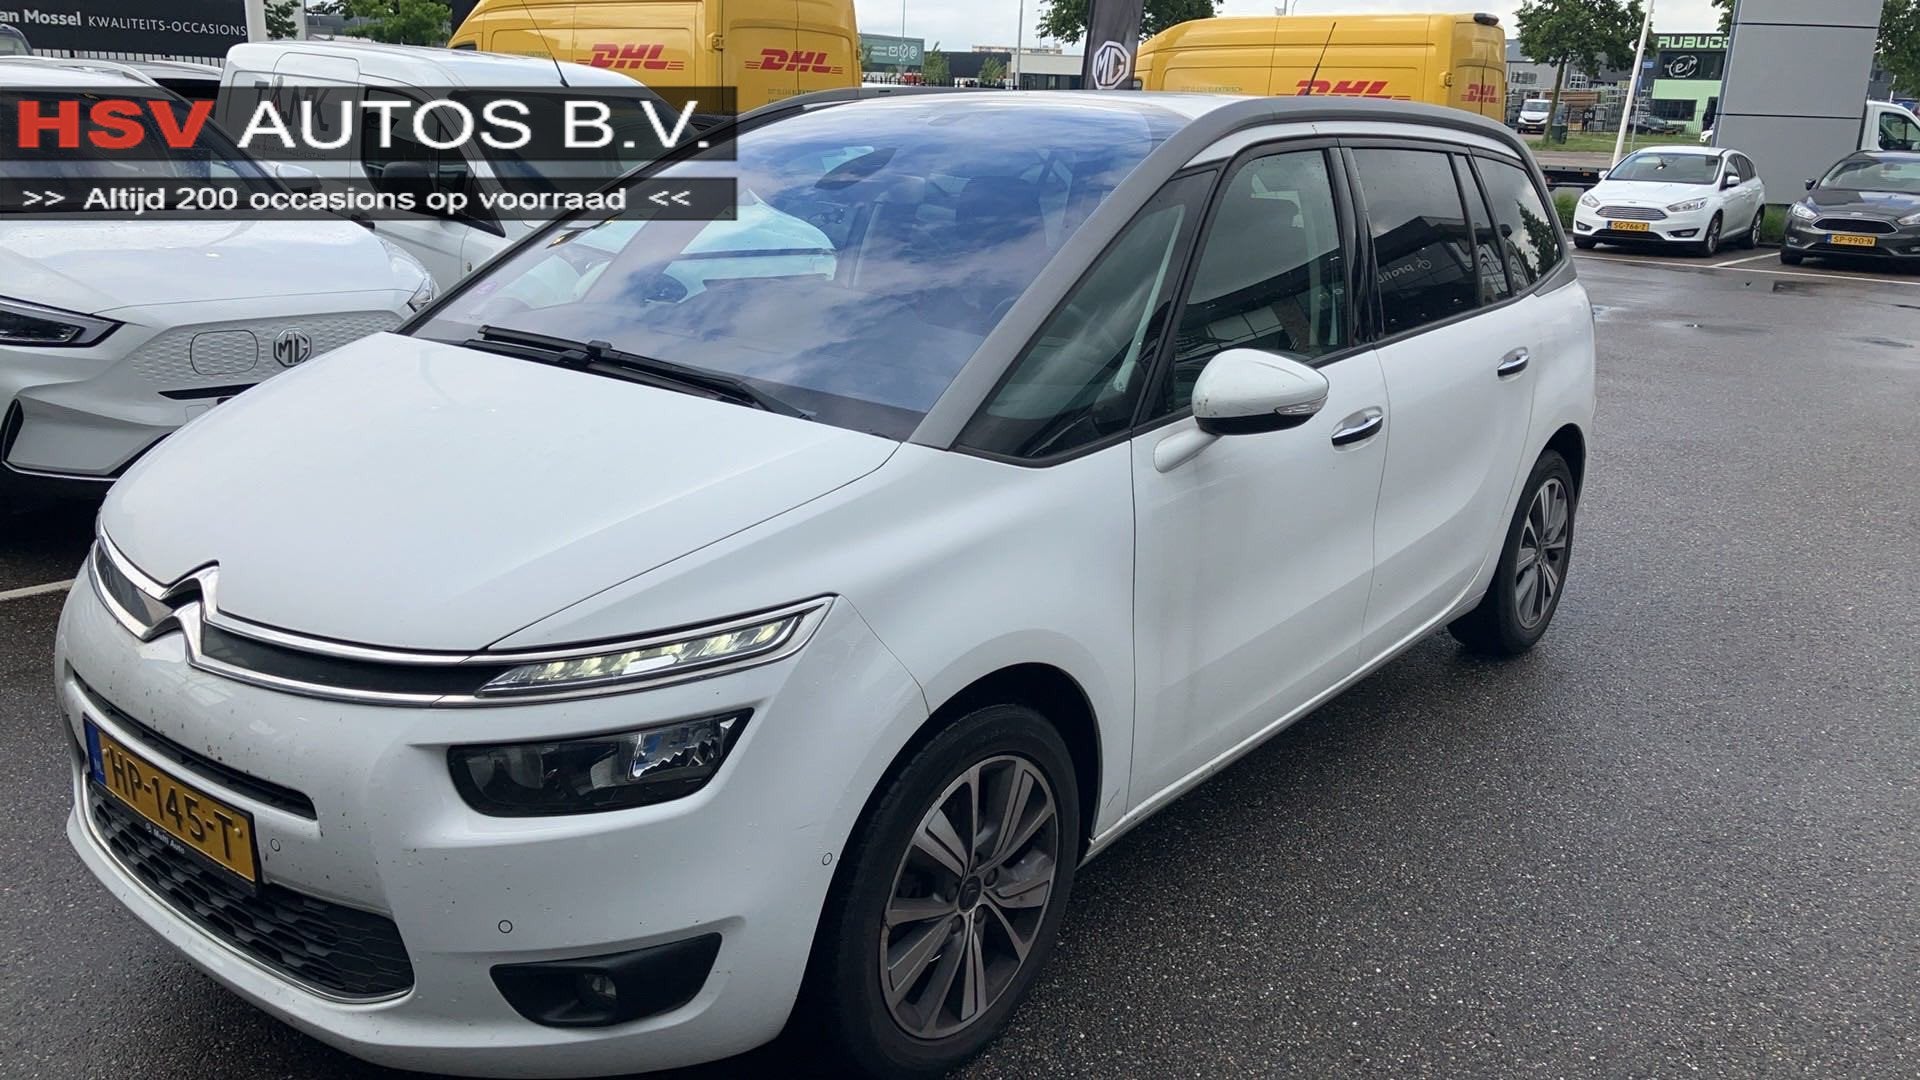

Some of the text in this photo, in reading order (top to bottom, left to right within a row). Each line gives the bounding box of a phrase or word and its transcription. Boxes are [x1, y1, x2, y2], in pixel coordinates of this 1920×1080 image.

[0, 9, 82, 26] an Mossel
[88, 16, 247, 37] KWALITEITS-OCCASIONS
[588, 43, 668, 71] DHL
[759, 48, 832, 74] DHL
[1296, 80, 1392, 99] DHL
[1467, 83, 1497, 104] DHL
[1833, 234, 1874, 246] SP-990-N
[108, 744, 234, 862] HP-145-T
